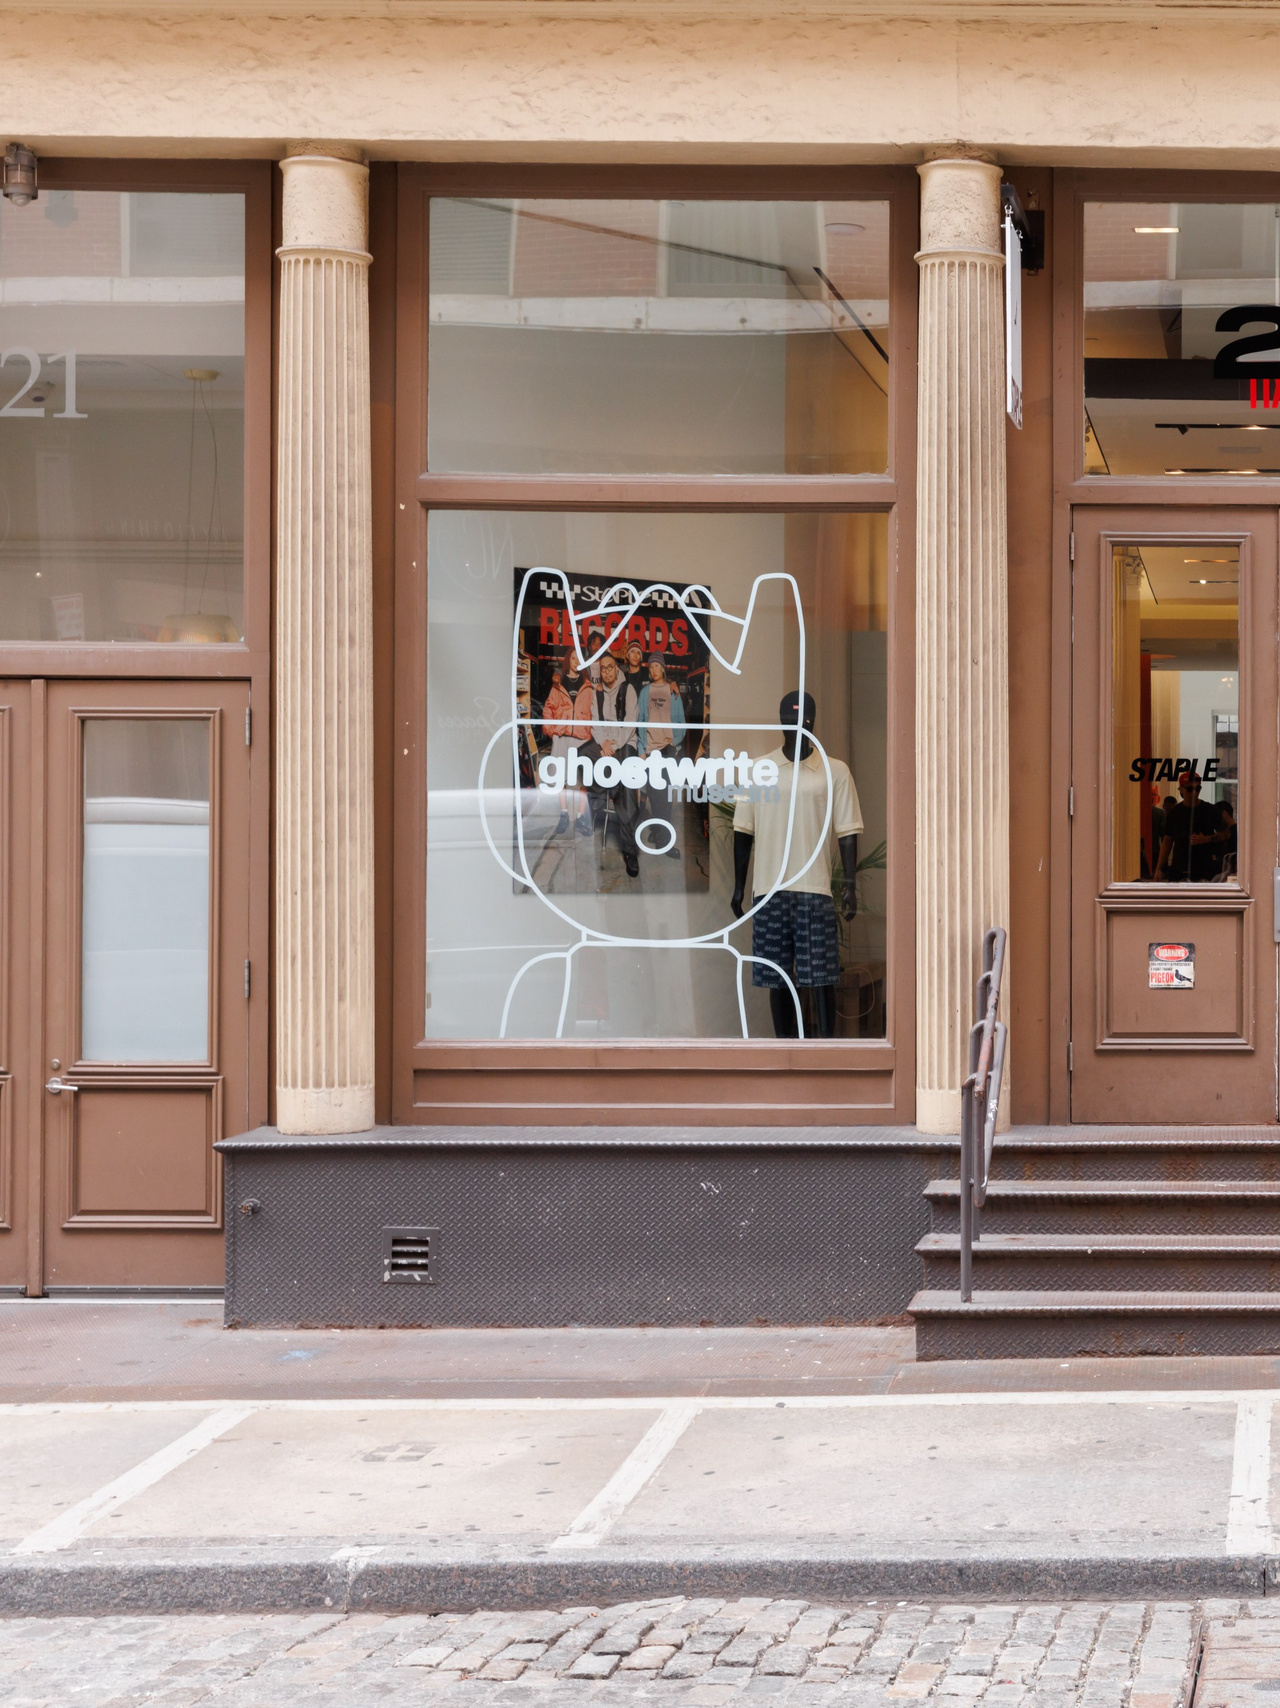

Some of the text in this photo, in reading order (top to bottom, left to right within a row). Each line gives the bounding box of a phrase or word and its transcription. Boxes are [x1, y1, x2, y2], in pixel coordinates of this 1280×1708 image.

[0, 346, 88, 418] 21
[539, 606, 689, 657] RECORDS
[538, 747, 779, 795] ghostwrite
[1129, 757, 1220, 783] STAPLE
[667, 783, 780, 803] museum
[1151, 972, 1174, 983] PIGEON
